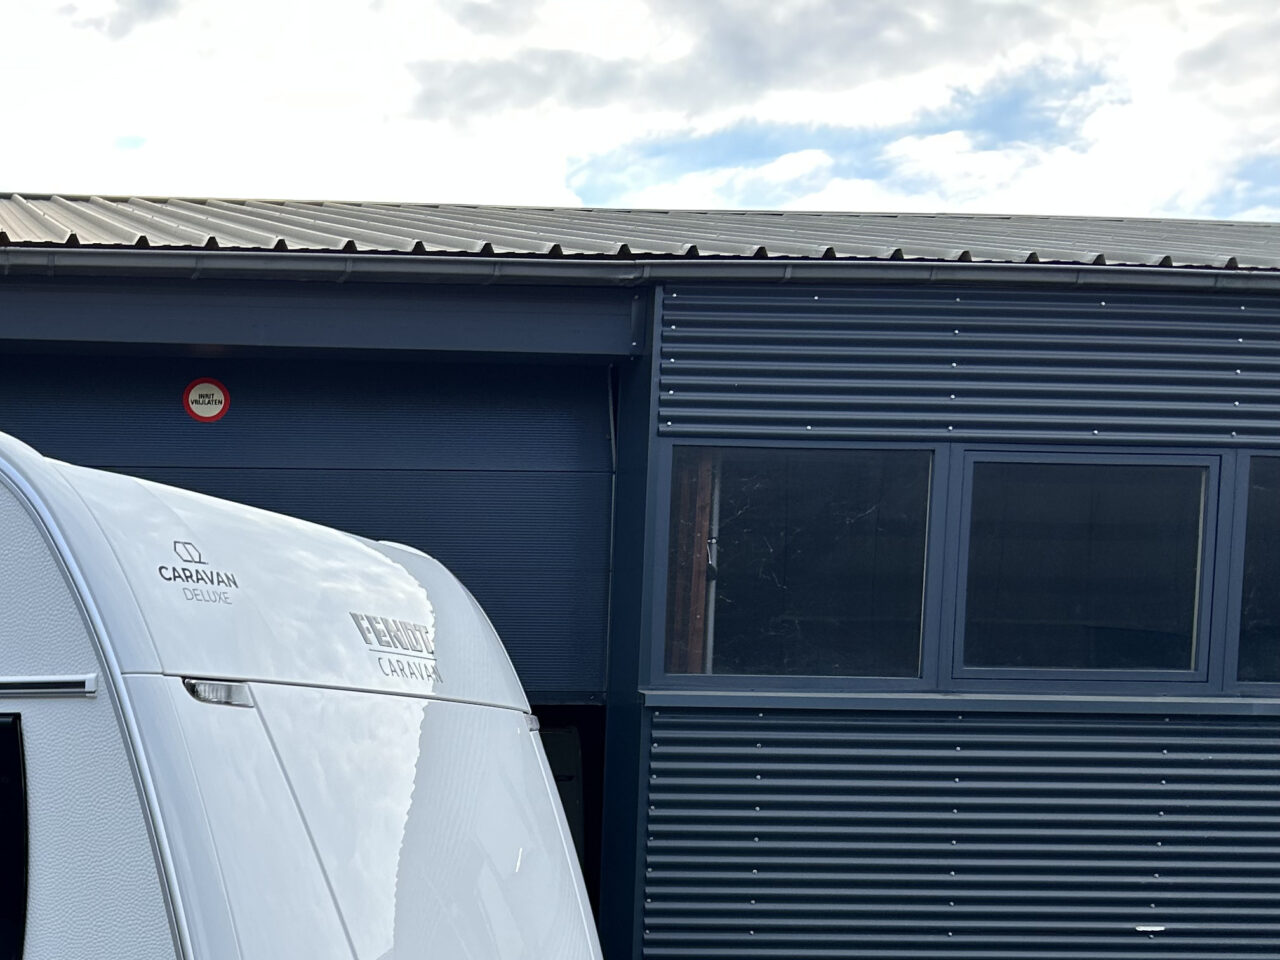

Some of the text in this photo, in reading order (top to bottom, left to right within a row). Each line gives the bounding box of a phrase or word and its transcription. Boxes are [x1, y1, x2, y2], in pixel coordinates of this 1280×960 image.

[158, 565, 239, 589] CARAVAN
[182, 587, 232, 604] DELUXE
[349, 611, 434, 654] FENDT
[378, 657, 444, 683] CARAVAN
